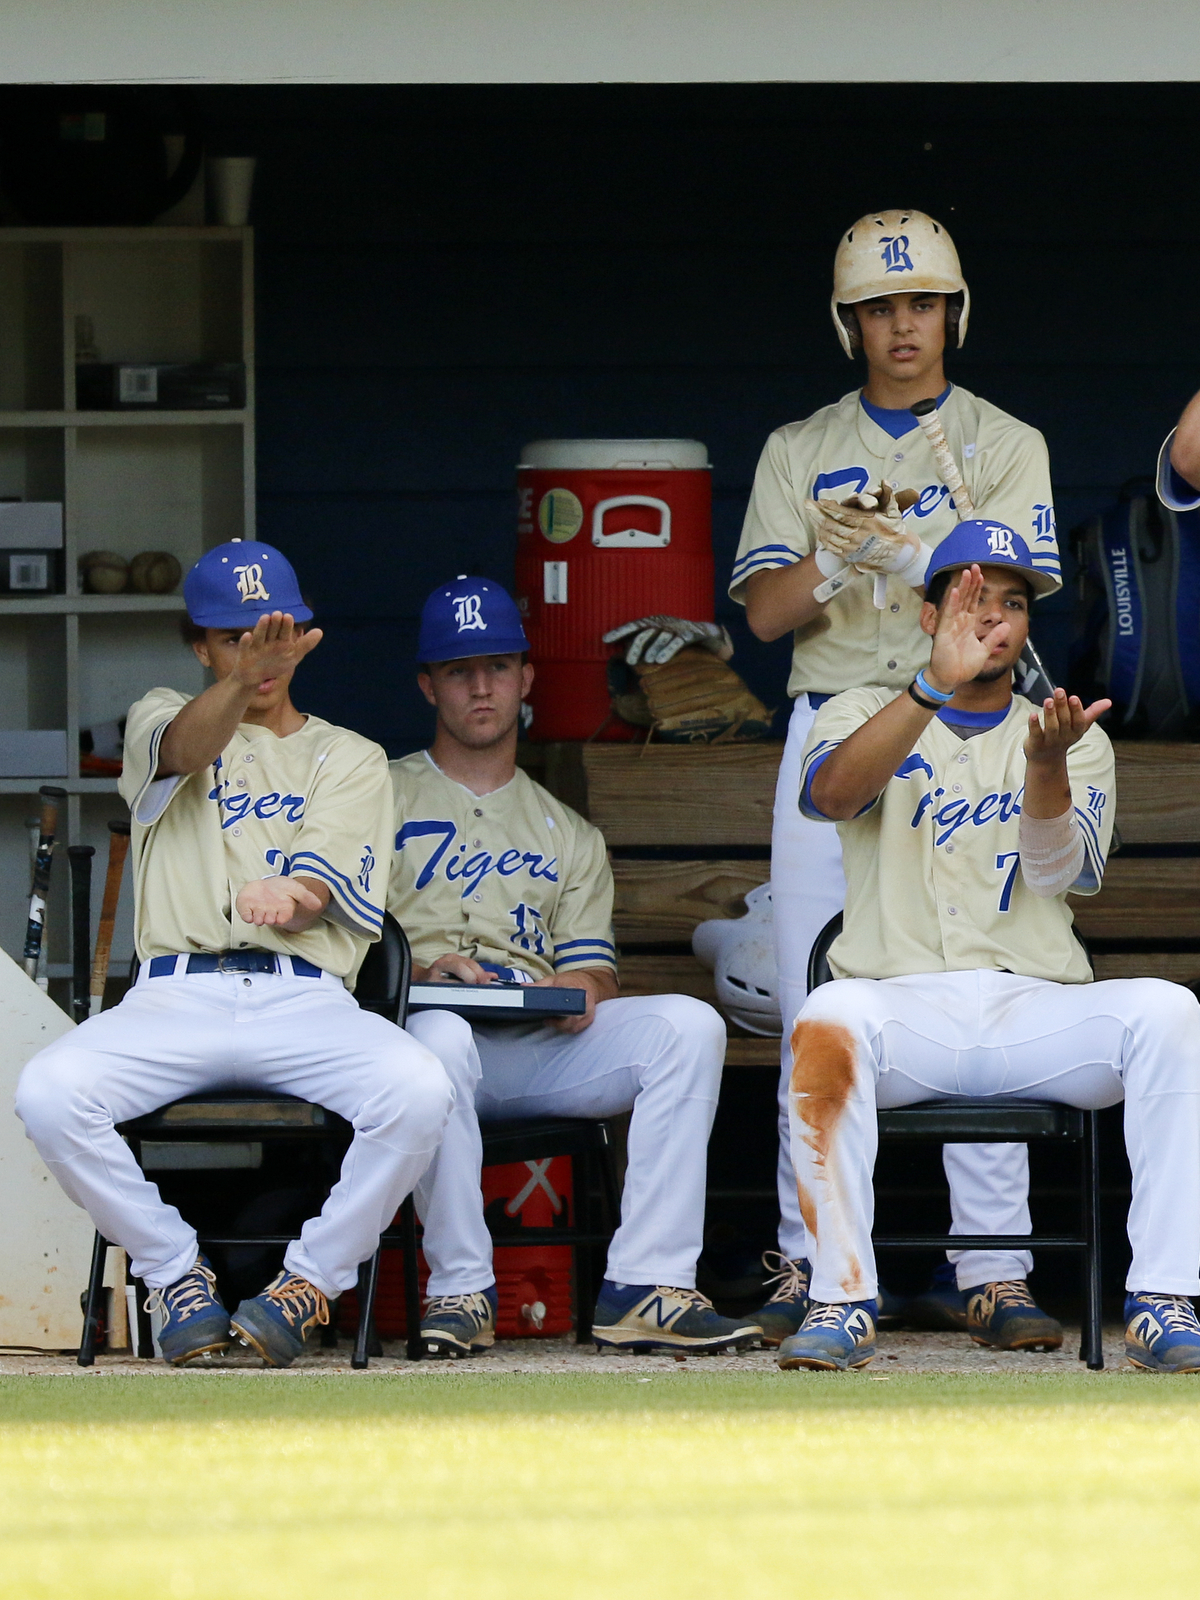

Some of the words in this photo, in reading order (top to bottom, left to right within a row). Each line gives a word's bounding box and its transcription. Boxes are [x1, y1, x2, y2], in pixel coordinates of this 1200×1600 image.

[878, 235, 914, 274] R
[984, 525, 1019, 562] R
[232, 563, 271, 604] R
[1111, 547, 1134, 637] LOUISVILLE
[452, 594, 488, 633] R
[994, 851, 1021, 913] 7
